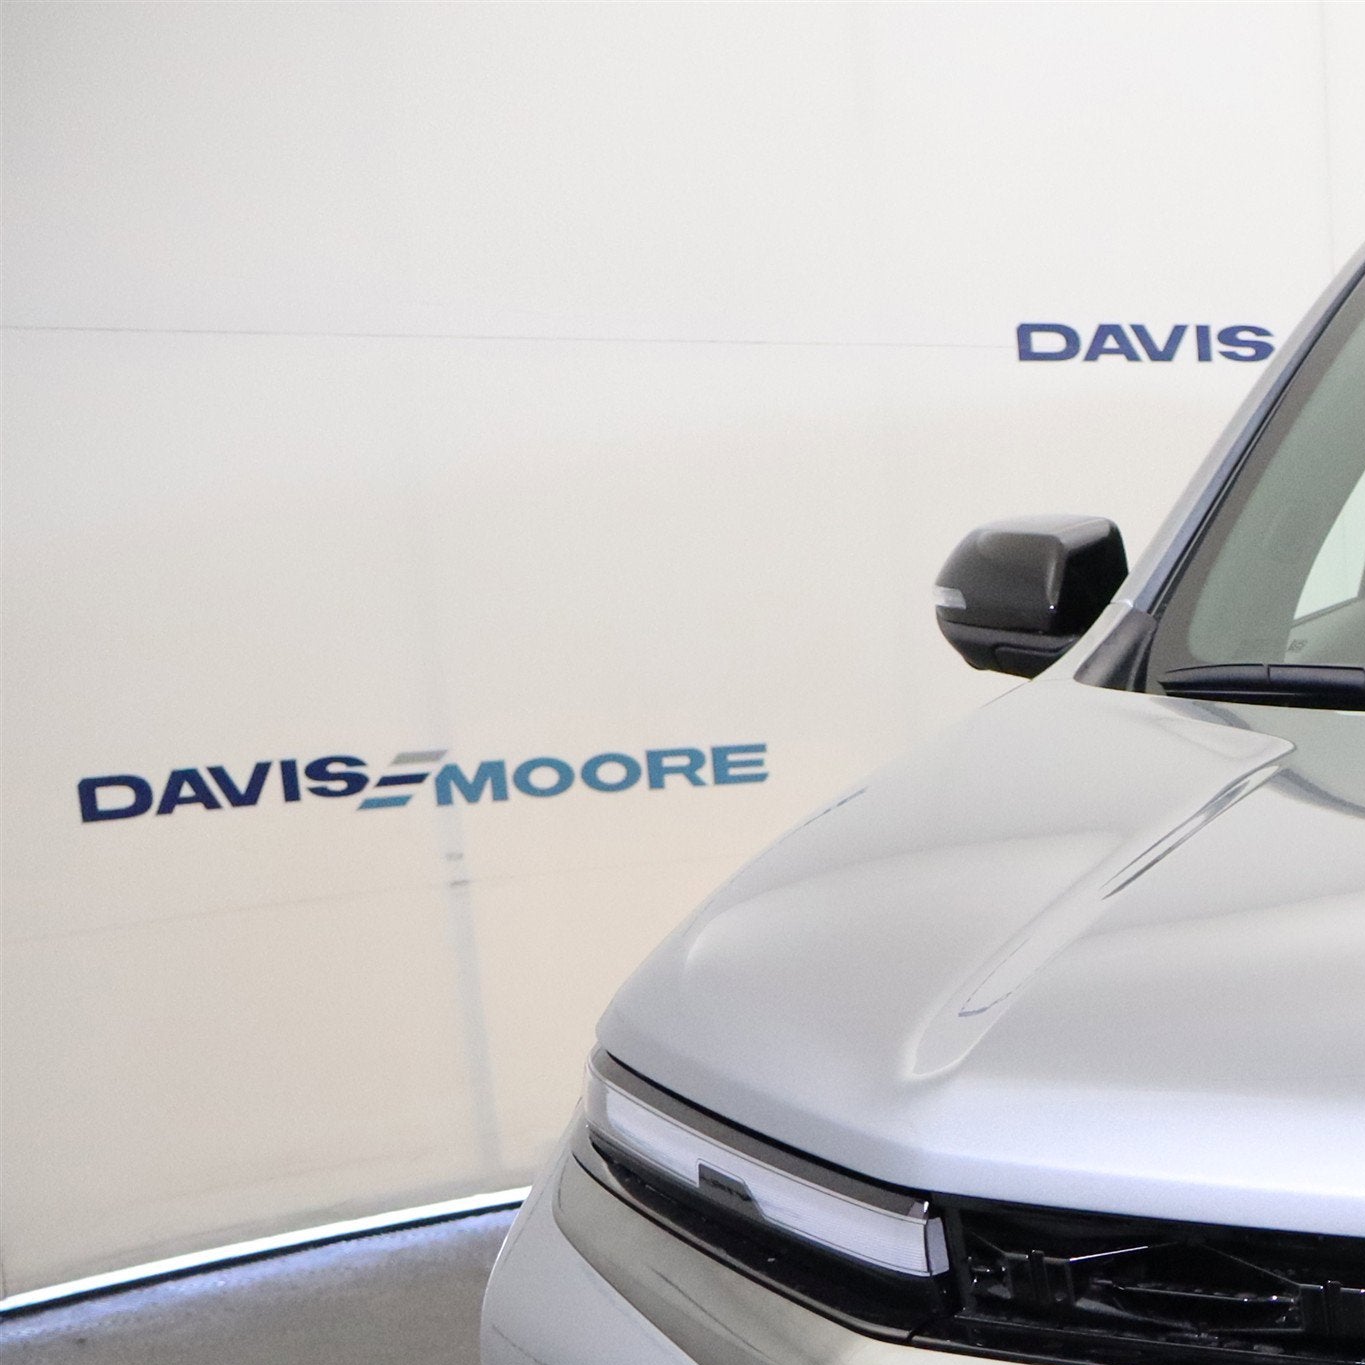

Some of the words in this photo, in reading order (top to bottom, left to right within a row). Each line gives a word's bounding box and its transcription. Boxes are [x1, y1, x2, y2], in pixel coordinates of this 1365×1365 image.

[1016, 323, 1276, 363] DAVIS
[76, 754, 372, 825] DAVIS
[433, 743, 770, 807] MOORE
